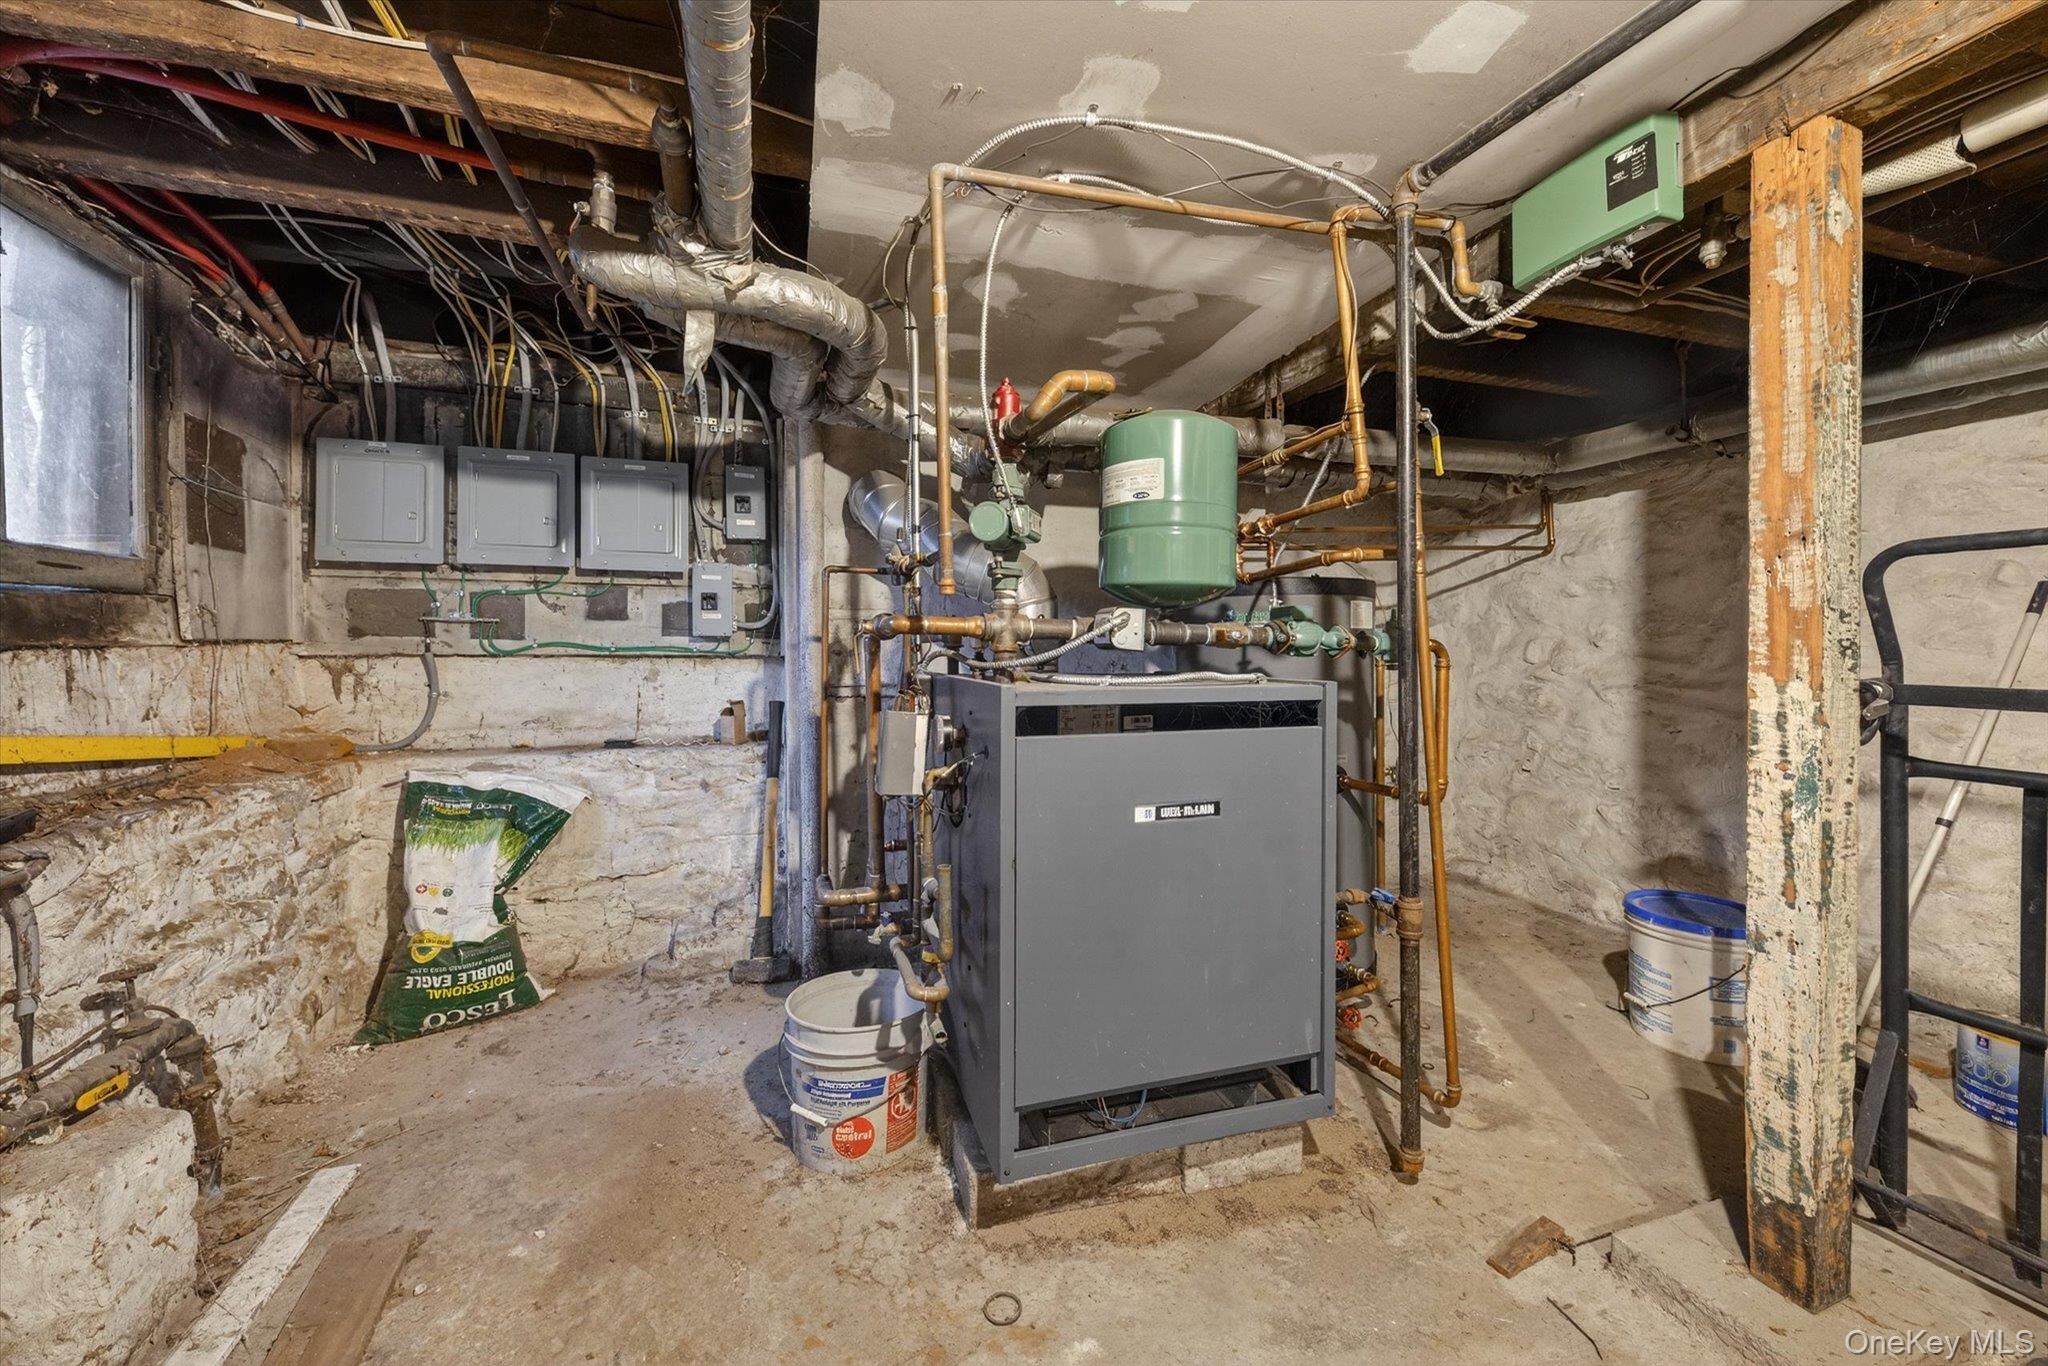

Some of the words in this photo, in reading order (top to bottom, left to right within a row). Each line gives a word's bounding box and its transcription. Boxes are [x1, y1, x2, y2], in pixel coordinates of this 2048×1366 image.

[401, 974, 452, 989] EAGLE
[457, 959, 514, 985] DOUBLE
[426, 972, 515, 1000] PROFESSIONAL
[421, 988, 517, 1030] LESCO
